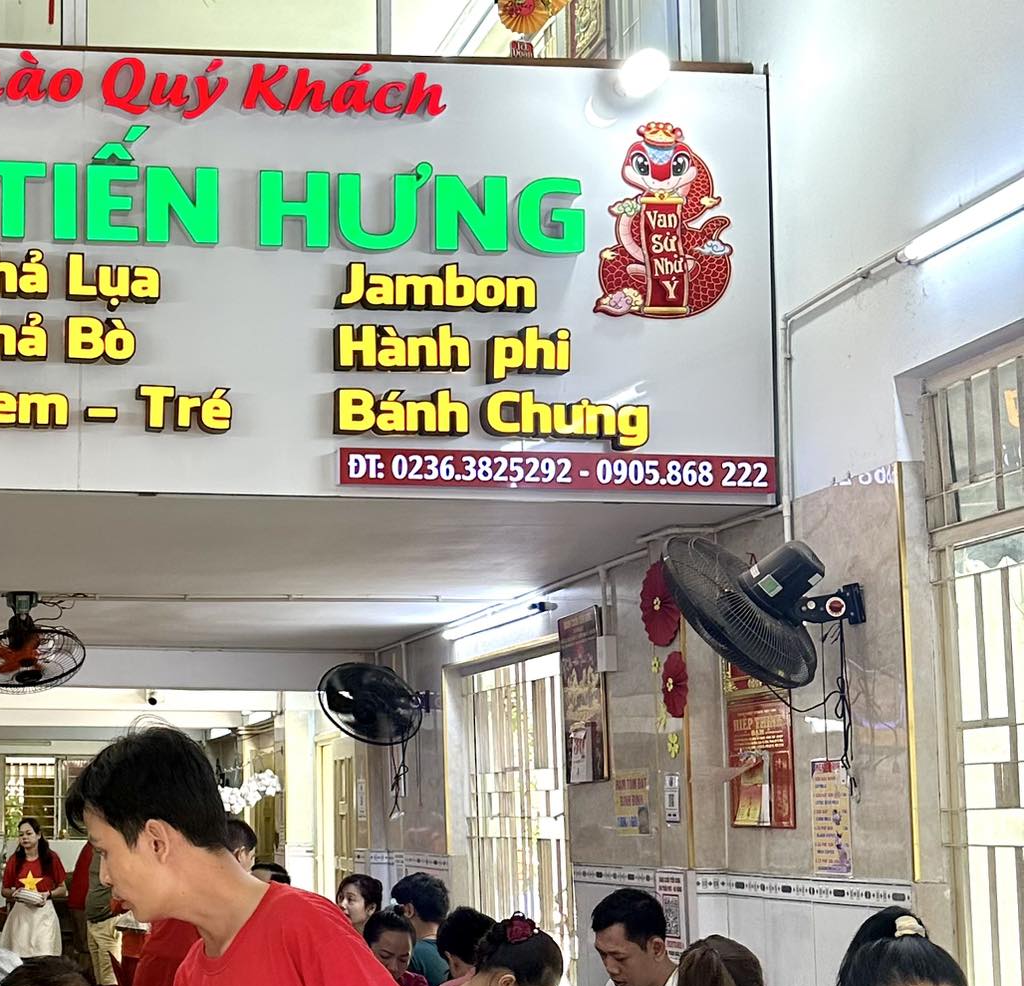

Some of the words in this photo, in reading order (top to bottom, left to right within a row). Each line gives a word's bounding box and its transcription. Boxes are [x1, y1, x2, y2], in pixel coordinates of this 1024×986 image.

[101, 57, 229, 120] Quý
[241, 63, 448, 117] Khách
[258, 161, 586, 255] HƯNG
[66, 252, 161, 312] Lụa
[336, 262, 537, 313] Jambon
[662, 276, 679, 299] Ý
[65, 316, 136, 364] Bò
[334, 323, 471, 371] Hành
[487, 325, 571, 383] phi
[136, 385, 232, 434] Tré
[334, 388, 470, 435] Bánh
[480, 390, 650, 450] Chưng
[348, 454, 385, 480] ĐT:
[391, 455, 572, 484] 0236.3825292
[596, 459, 714, 486] 0905.868
[721, 461, 769, 488] 222
